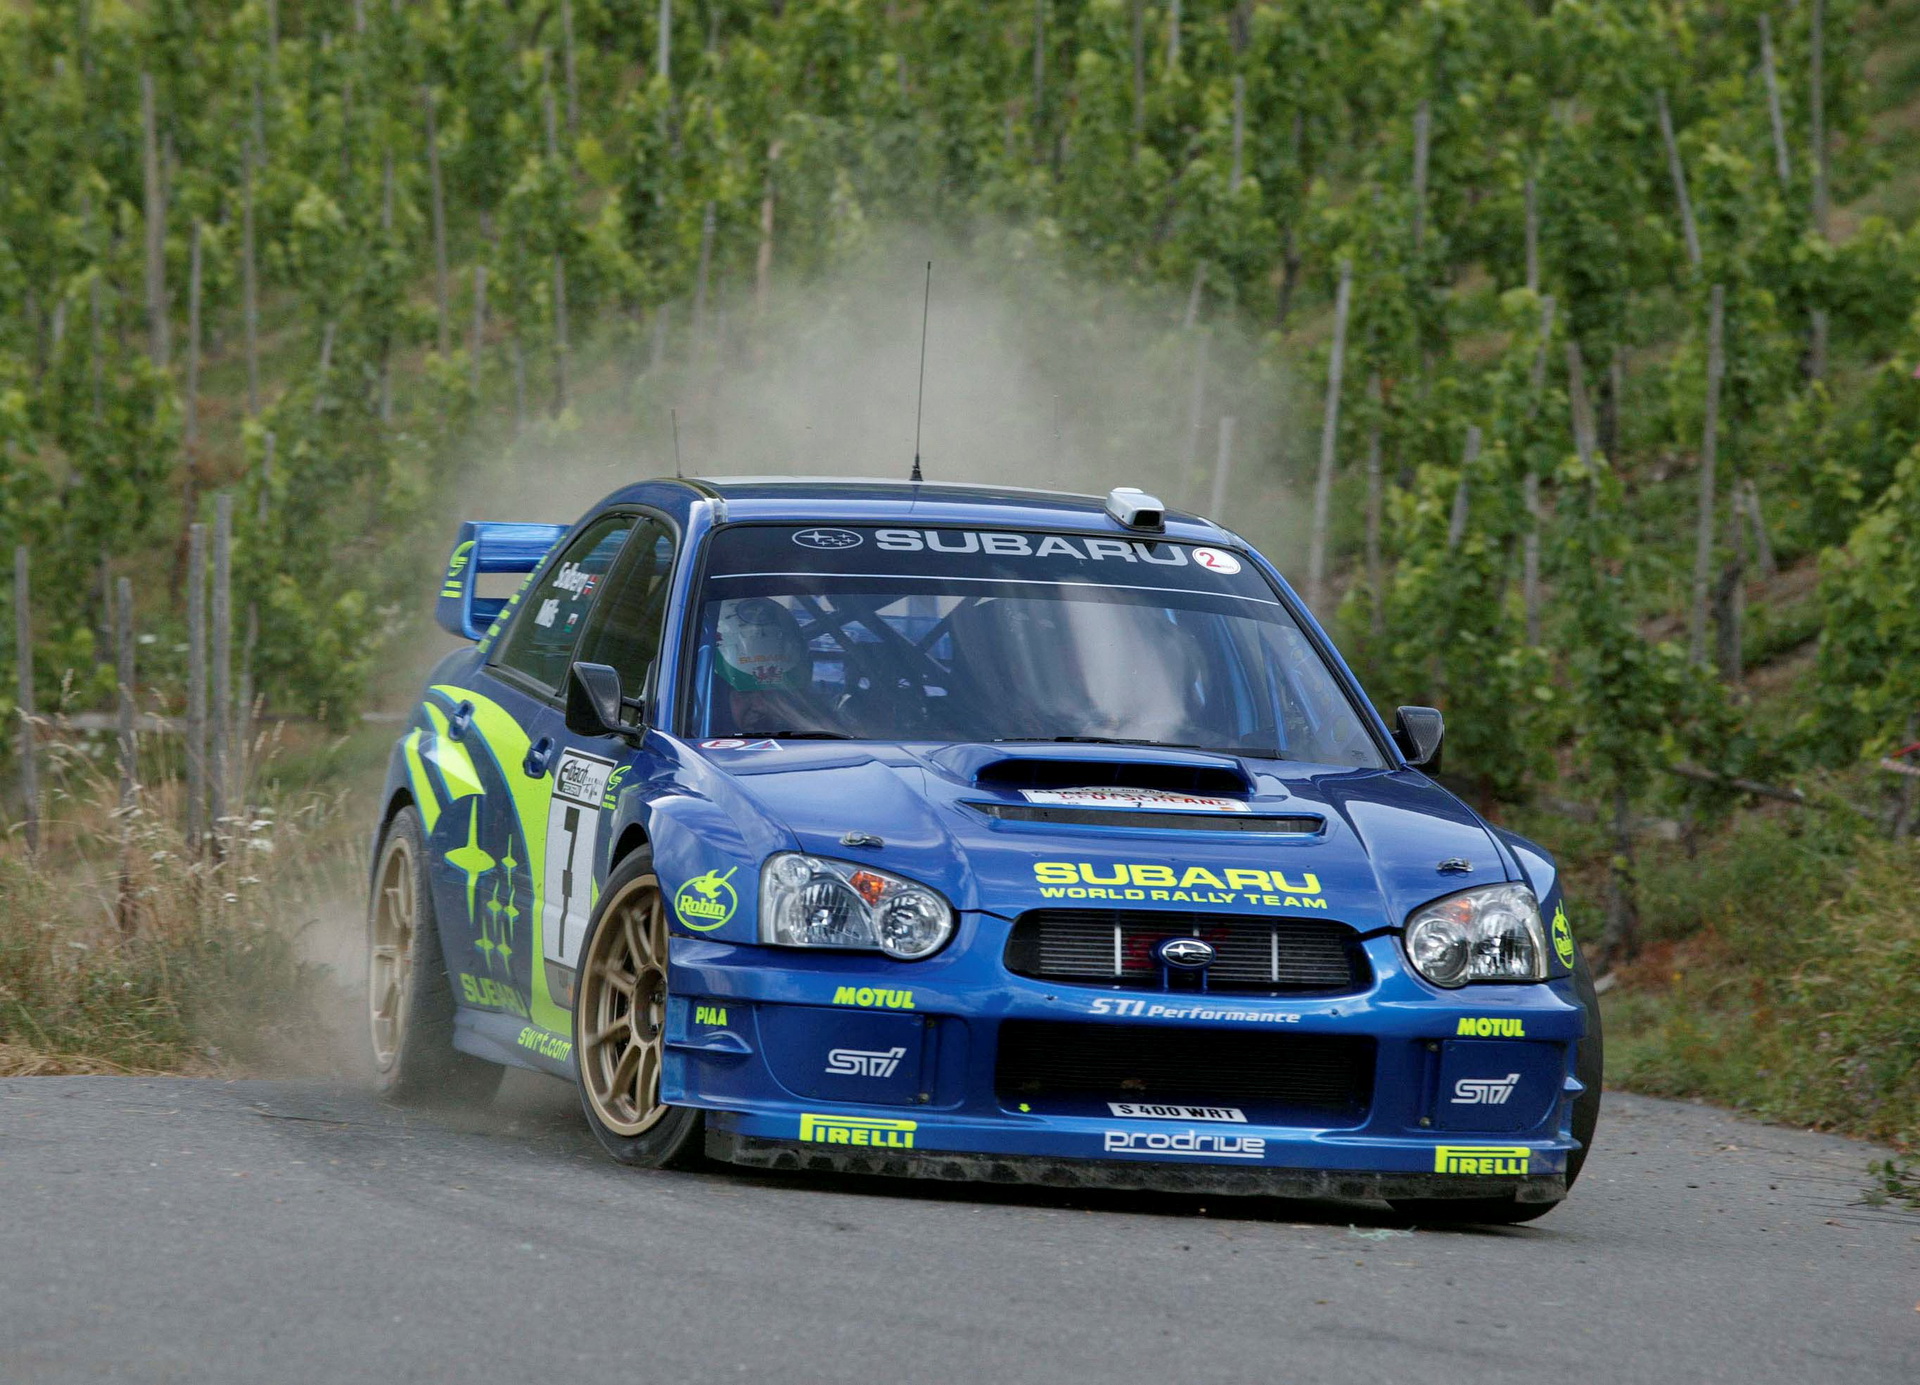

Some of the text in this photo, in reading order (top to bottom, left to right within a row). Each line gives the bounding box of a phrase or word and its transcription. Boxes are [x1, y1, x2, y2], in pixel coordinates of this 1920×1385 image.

[875, 530, 1188, 566] SUBARU
[1199, 552, 1221, 568] 2
[1034, 862, 1322, 894] SUBARU
[679, 895, 726, 919] Robin
[1039, 887, 1328, 909] WORLD RALLY TEAM
[832, 986, 916, 1009] MOTUL
[695, 1006, 728, 1026] PIAA
[1088, 998, 1302, 1024] STI Performance
[1456, 1017, 1526, 1037] MOTUL
[518, 1027, 572, 1061] swrt.com
[1119, 1104, 1236, 1119] S 400 WRT
[799, 1113, 918, 1149] PIRELLI
[1104, 1129, 1266, 1156] prodrive
[1434, 1145, 1531, 1175] PIRELLI
